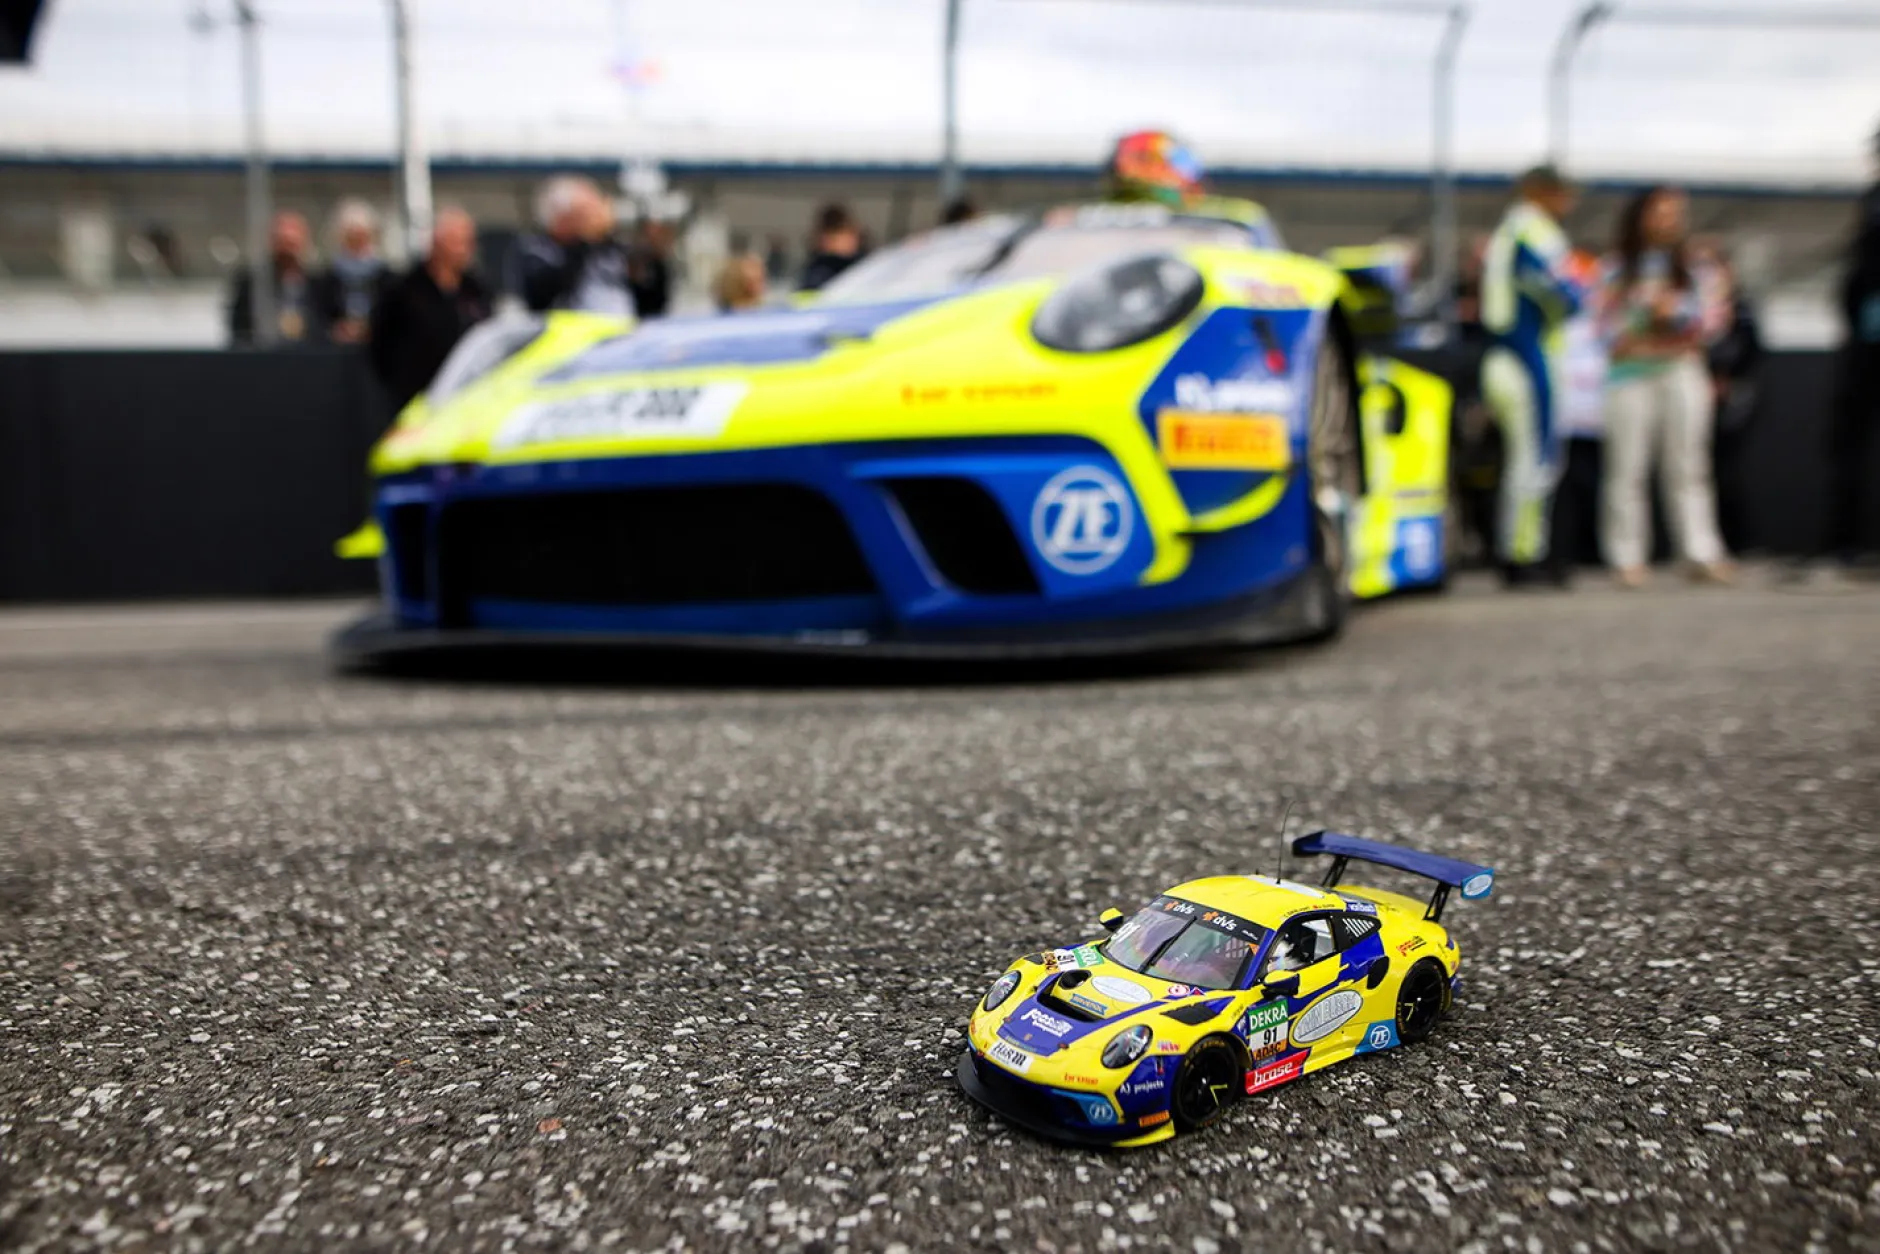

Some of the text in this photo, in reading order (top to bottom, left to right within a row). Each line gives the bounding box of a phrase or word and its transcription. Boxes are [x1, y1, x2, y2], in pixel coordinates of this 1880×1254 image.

[1038, 480, 1127, 558] ZF
[1173, 903, 1195, 914] dvs
[1213, 916, 1237, 931] dvs
[1250, 1003, 1288, 1031] DEKRA
[1264, 1026, 1278, 1046] 91
[1372, 1029, 1388, 1046] ZF
[1255, 1042, 1282, 1060] ADAC
[1254, 1062, 1293, 1086] brose
[1134, 1080, 1164, 1095] projects
